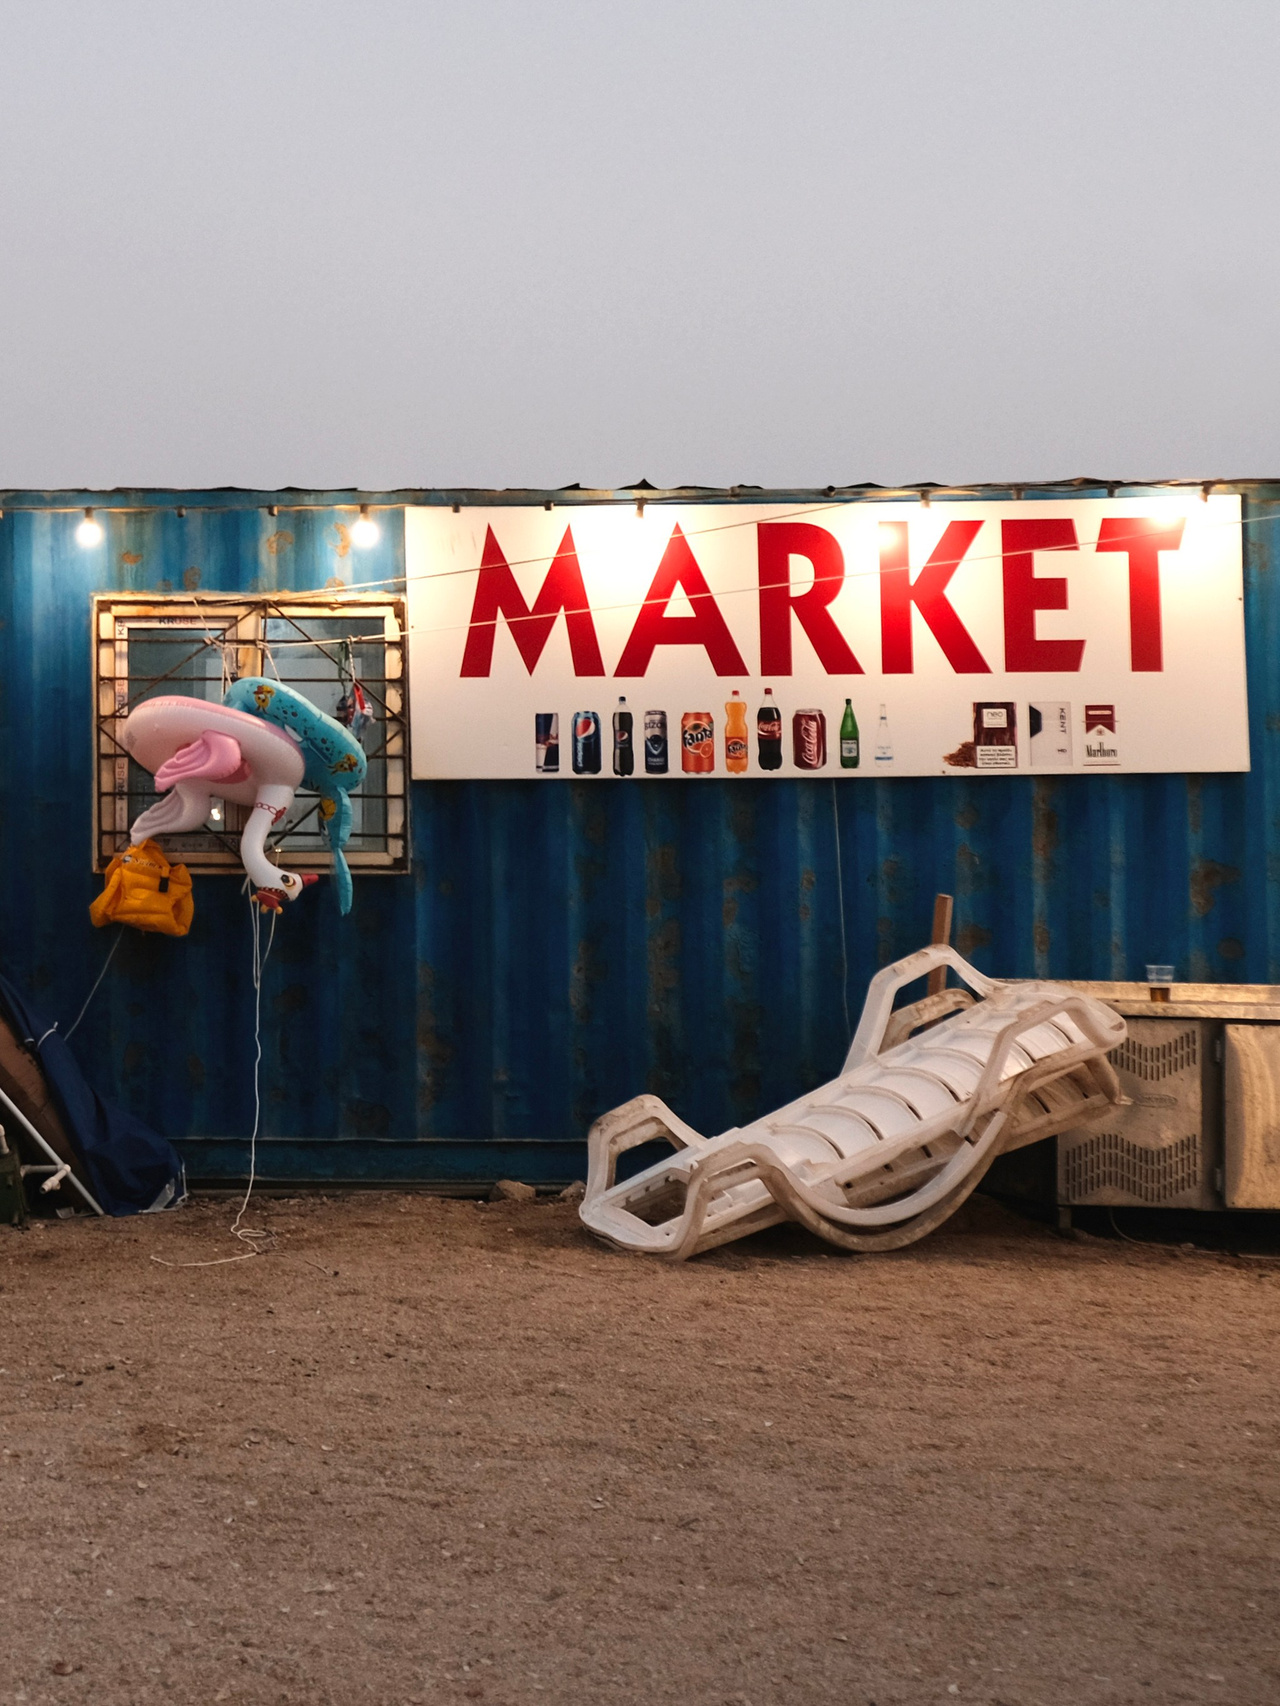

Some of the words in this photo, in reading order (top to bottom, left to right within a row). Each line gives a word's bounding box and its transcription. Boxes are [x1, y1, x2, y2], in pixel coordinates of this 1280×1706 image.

[459, 517, 1186, 678] MARKET
[1059, 707, 1068, 734] KENT
[683, 727, 713, 748] Fanta
[802, 719, 818, 765] Coca-Cola
[1086, 742, 1118, 758] Marlboro
